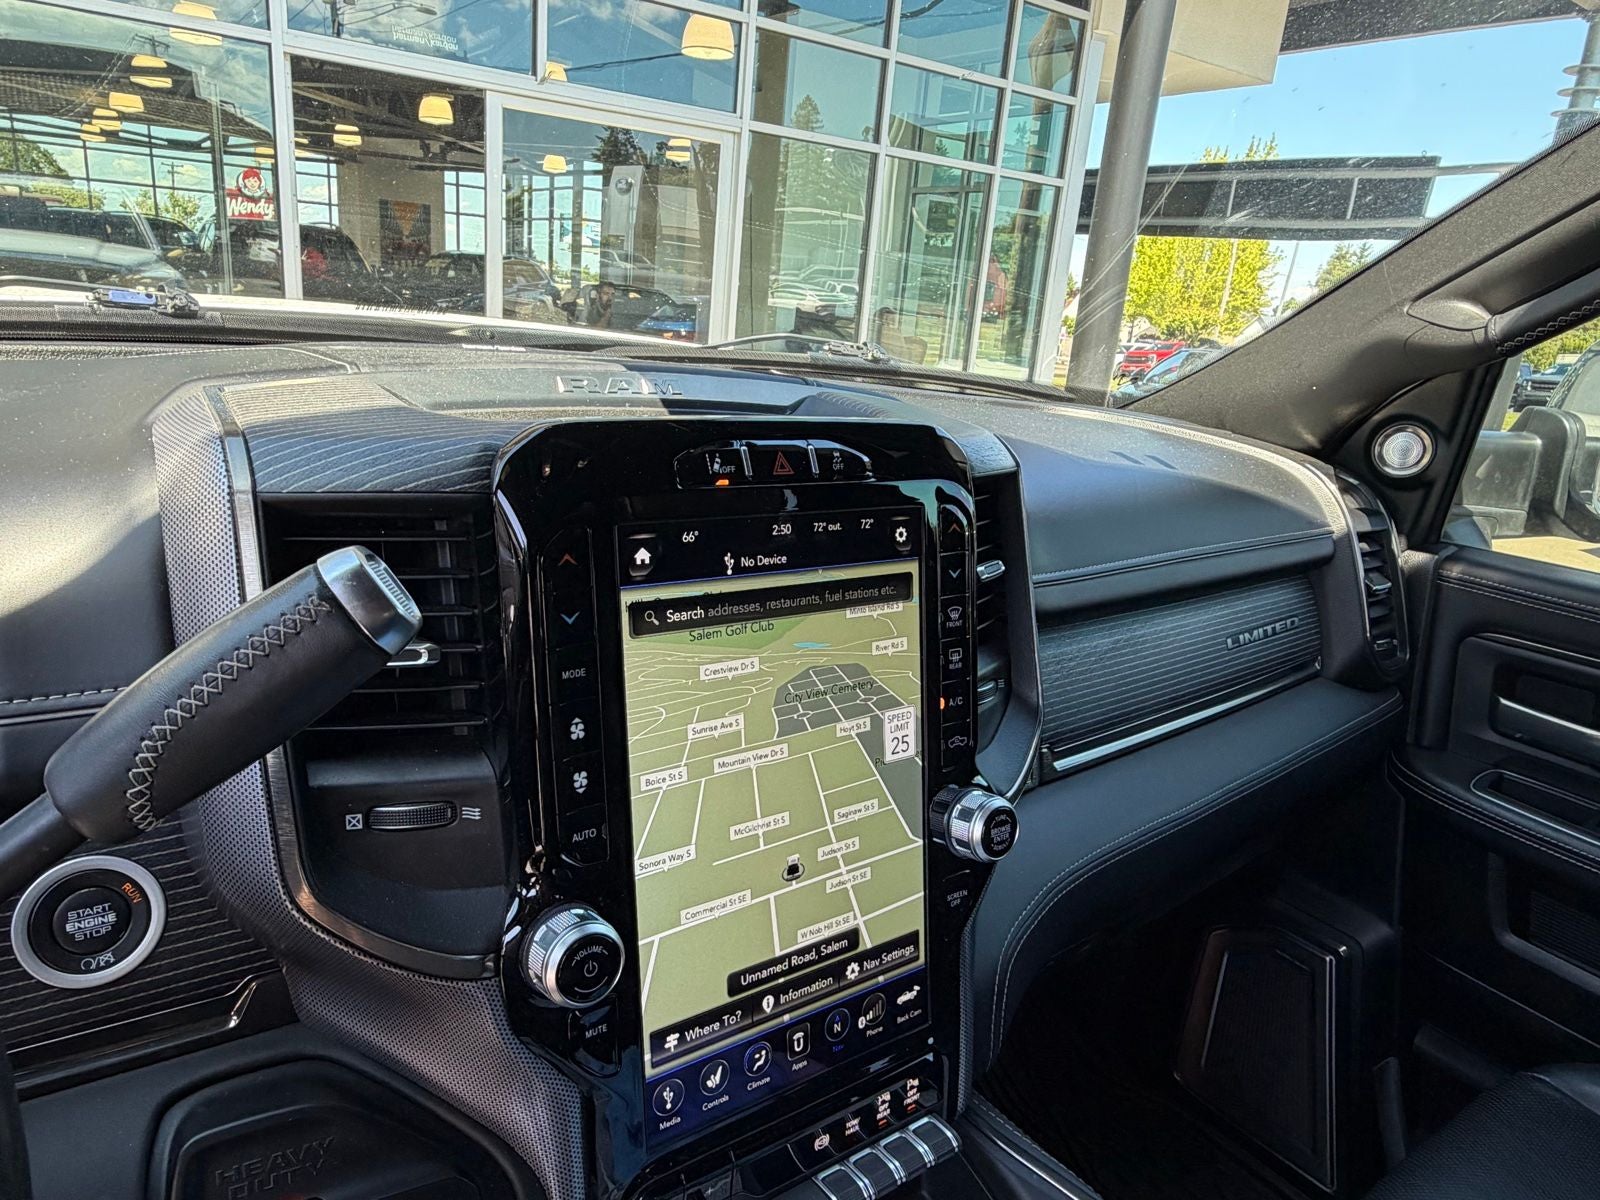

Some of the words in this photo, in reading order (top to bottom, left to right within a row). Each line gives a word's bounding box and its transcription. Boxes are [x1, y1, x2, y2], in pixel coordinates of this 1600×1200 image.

[556, 375, 683, 396] RAM
[722, 465, 736, 473] OFF
[832, 463, 845, 471] OFF
[772, 524, 792, 535] 2:50
[813, 522, 827, 532] 72°
[860, 519, 874, 529] 72°
[682, 531, 699, 543] 66°
[740, 557, 755, 567] No
[757, 555, 788, 566] Device
[666, 606, 705, 622] Search
[708, 602, 764, 617] addresses,
[766, 594, 823, 610] restaurants,
[825, 589, 843, 602] fuel
[844, 587, 879, 600] stations
[881, 585, 897, 595] etc.
[689, 629, 722, 642] Salem
[725, 623, 748, 637] Golf
[750, 619, 775, 633] Club
[946, 620, 963, 629] FRONT
[1226, 616, 1300, 650] LIMITED
[875, 644, 890, 652] River
[891, 641, 899, 650] Rd
[899, 640, 905, 648] S
[561, 667, 587, 680] MODE
[704, 664, 739, 677] Crestview
[740, 662, 750, 671] Dr
[750, 660, 756, 669] S
[784, 692, 804, 704] City
[805, 688, 829, 700] View
[831, 680, 875, 695] Cemetery
[948, 696, 964, 707] A/C
[886, 710, 912, 724] SPEED
[691, 724, 718, 736] Sunrise
[719, 721, 734, 732] Ave
[735, 718, 741, 728] S
[840, 724, 855, 734] Hoyt
[855, 723, 863, 731] St
[889, 721, 910, 734] LIMIT
[891, 734, 910, 755] 25
[717, 757, 751, 770] Mountain
[752, 752, 769, 762] View
[770, 749, 779, 757] Dr
[779, 747, 785, 756] S
[645, 776, 667, 788] Boice
[668, 773, 677, 782] St
[677, 770, 683, 780] S
[837, 807, 863, 820] Saginaw
[863, 803, 870, 812] St
[870, 802, 875, 810] S
[733, 821, 772, 837] McGilchrist
[773, 818, 781, 827] St
[781, 815, 786, 824] S
[990, 824, 1011, 837] BROWSE
[572, 828, 597, 843] AUTO
[993, 832, 1010, 844] ENTER
[820, 846, 844, 858] Judson
[844, 842, 851, 851] St
[851, 840, 857, 848] S
[638, 858, 667, 871] Sonora
[668, 852, 685, 864] Way
[686, 849, 692, 858] S
[828, 877, 852, 890] Judson
[852, 873, 859, 882] St
[859, 870, 868, 880] SE
[121, 882, 143, 905] RUN
[946, 889, 968, 902] SCREEN
[67, 902, 112, 920] START
[684, 902, 728, 921] Commercial
[729, 898, 737, 907] St
[737, 894, 747, 904] SE
[950, 898, 961, 908] OFF
[65, 912, 118, 932] ENGINE
[800, 931, 808, 940] W
[808, 926, 823, 938] Nob
[824, 922, 834, 932] Hill
[834, 920, 842, 928] St
[842, 915, 850, 924] SE
[74, 925, 112, 941] STOP
[573, 945, 604, 961] VOLUME
[863, 957, 880, 971] Nav
[881, 944, 915, 964] Settings
[741, 960, 789, 986] Unnamed
[791, 949, 819, 967] Road,
[820, 938, 849, 956] Salem
[779, 976, 834, 1005] Information
[896, 1013, 909, 1024] Back
[909, 1008, 922, 1018] Cam
[584, 1023, 608, 1039] MUTE
[684, 1022, 720, 1042] Where
[722, 1010, 742, 1028] To?
[833, 1022, 842, 1034] N
[866, 1026, 884, 1037] Phone
[791, 1059, 808, 1072] Apps
[747, 1075, 771, 1091] Climate
[903, 1092, 921, 1106] FRONT
[906, 1087, 918, 1098] OFF
[702, 1094, 730, 1111] Controls
[878, 1102, 890, 1112] OFF
[876, 1108, 891, 1120] REAR
[659, 1115, 682, 1130] Media
[845, 1124, 860, 1136] HAUL
[215, 1135, 336, 1186] HEAVY
